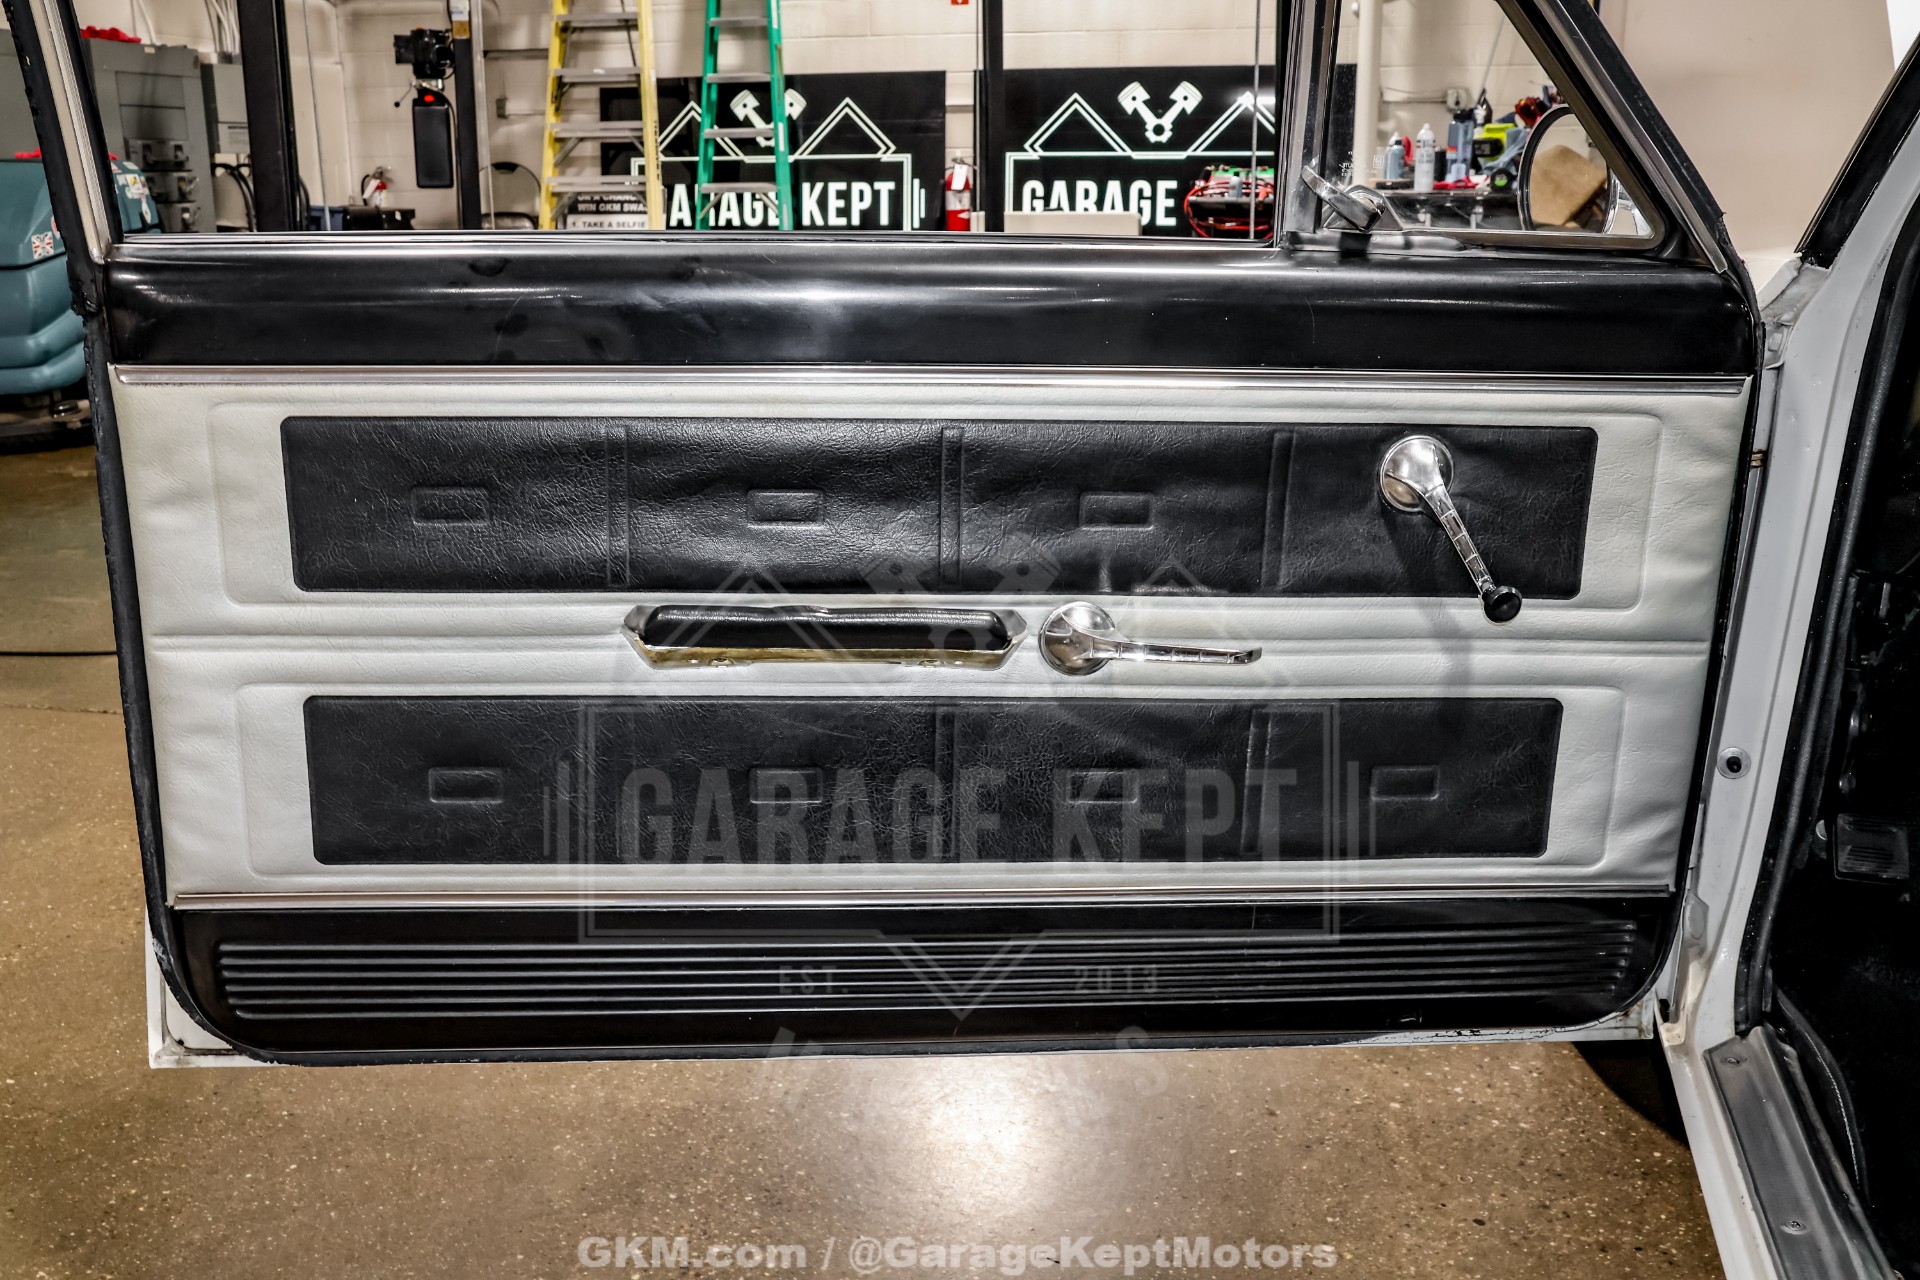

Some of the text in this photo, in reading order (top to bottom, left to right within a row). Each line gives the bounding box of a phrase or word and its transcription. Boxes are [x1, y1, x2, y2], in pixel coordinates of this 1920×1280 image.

[577, 203, 648, 213] WIN GKM SWA
[670, 181, 896, 227] AAGE KEPT
[1022, 180, 1178, 227] GARAGE
[582, 221, 604, 229] TAKE
[607, 221, 613, 229] A
[616, 221, 647, 229] SELFIE
